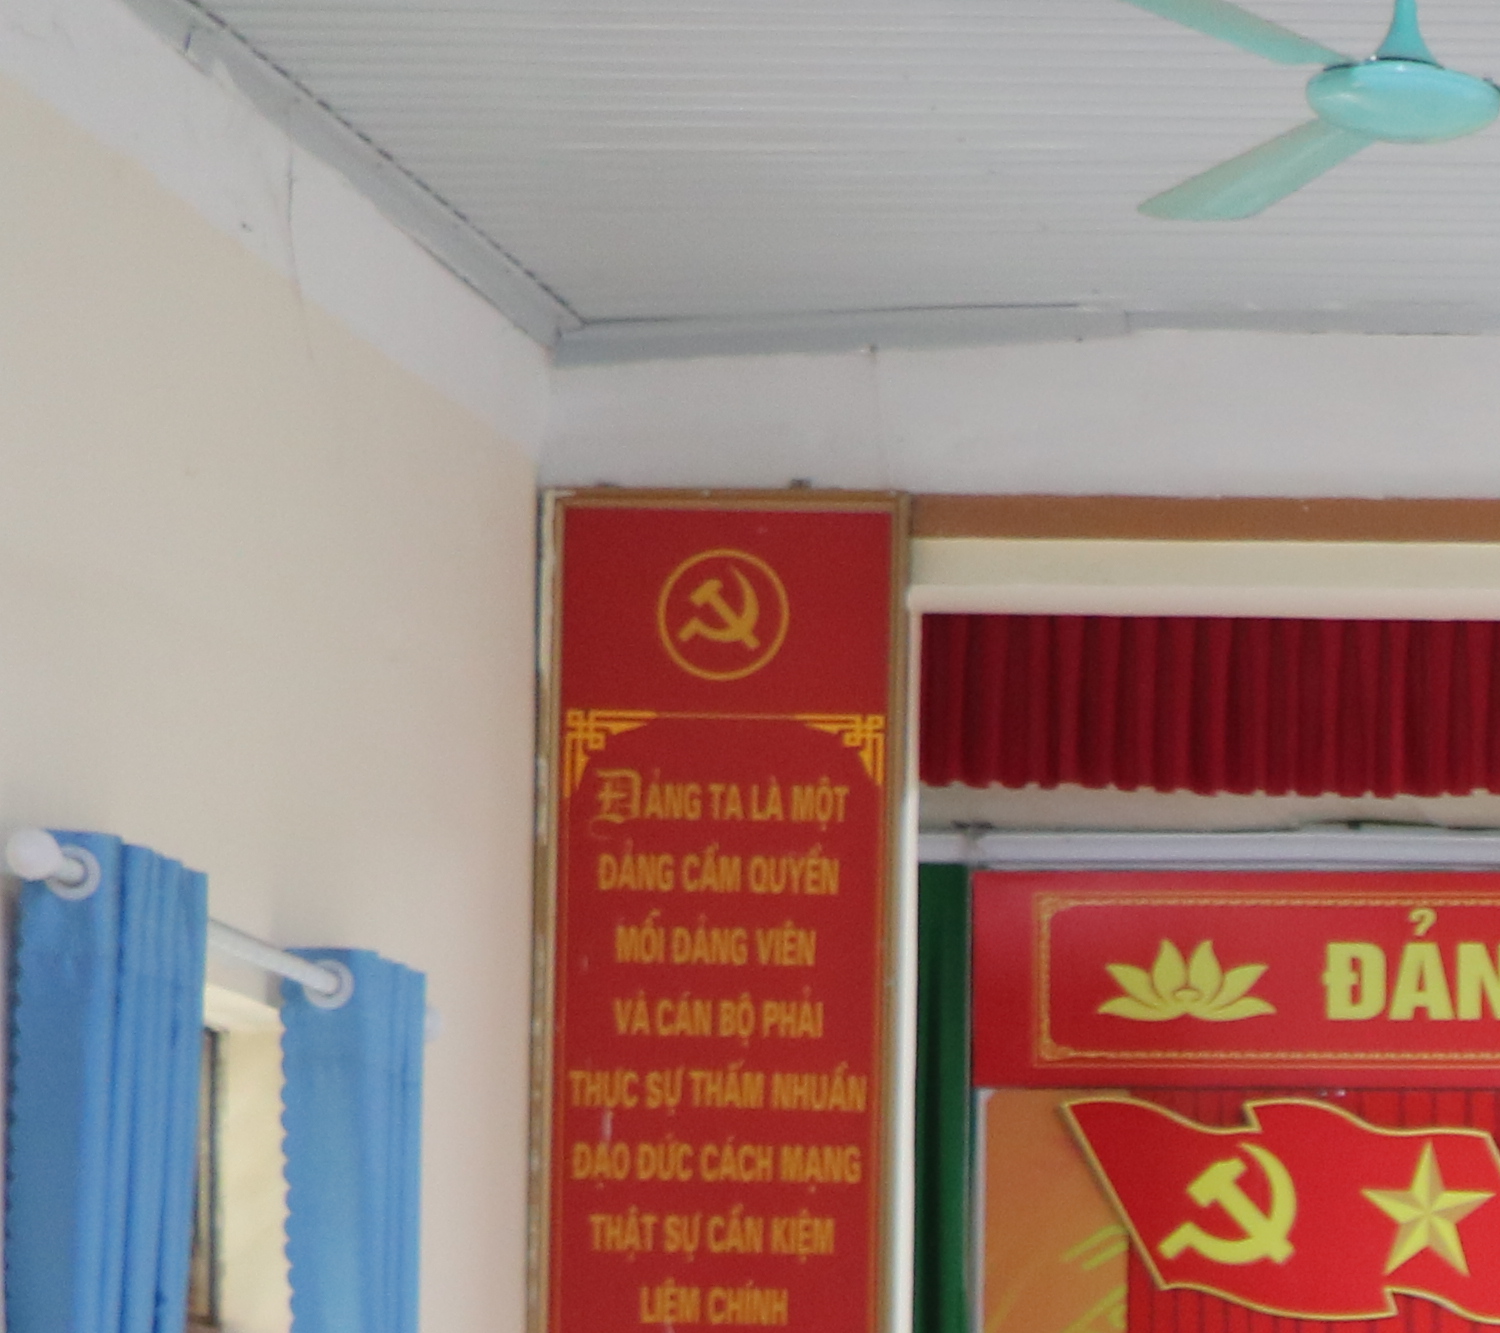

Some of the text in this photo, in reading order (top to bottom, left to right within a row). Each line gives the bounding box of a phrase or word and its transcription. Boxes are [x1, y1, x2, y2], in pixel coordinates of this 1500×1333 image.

[708, 783, 743, 821] TA
[749, 775, 784, 821] LÀ
[791, 776, 850, 831] MỘT
[671, 913, 748, 965] ĐẢNG
[756, 919, 816, 966] VIÊN
[612, 985, 824, 1046] VÀ CÁN BỘ PHẢI
[571, 1133, 861, 1194] ĐẠO ĐỨC CÁCH MẠNG
[640, 1276, 788, 1325] LIÊM CHÍNH
